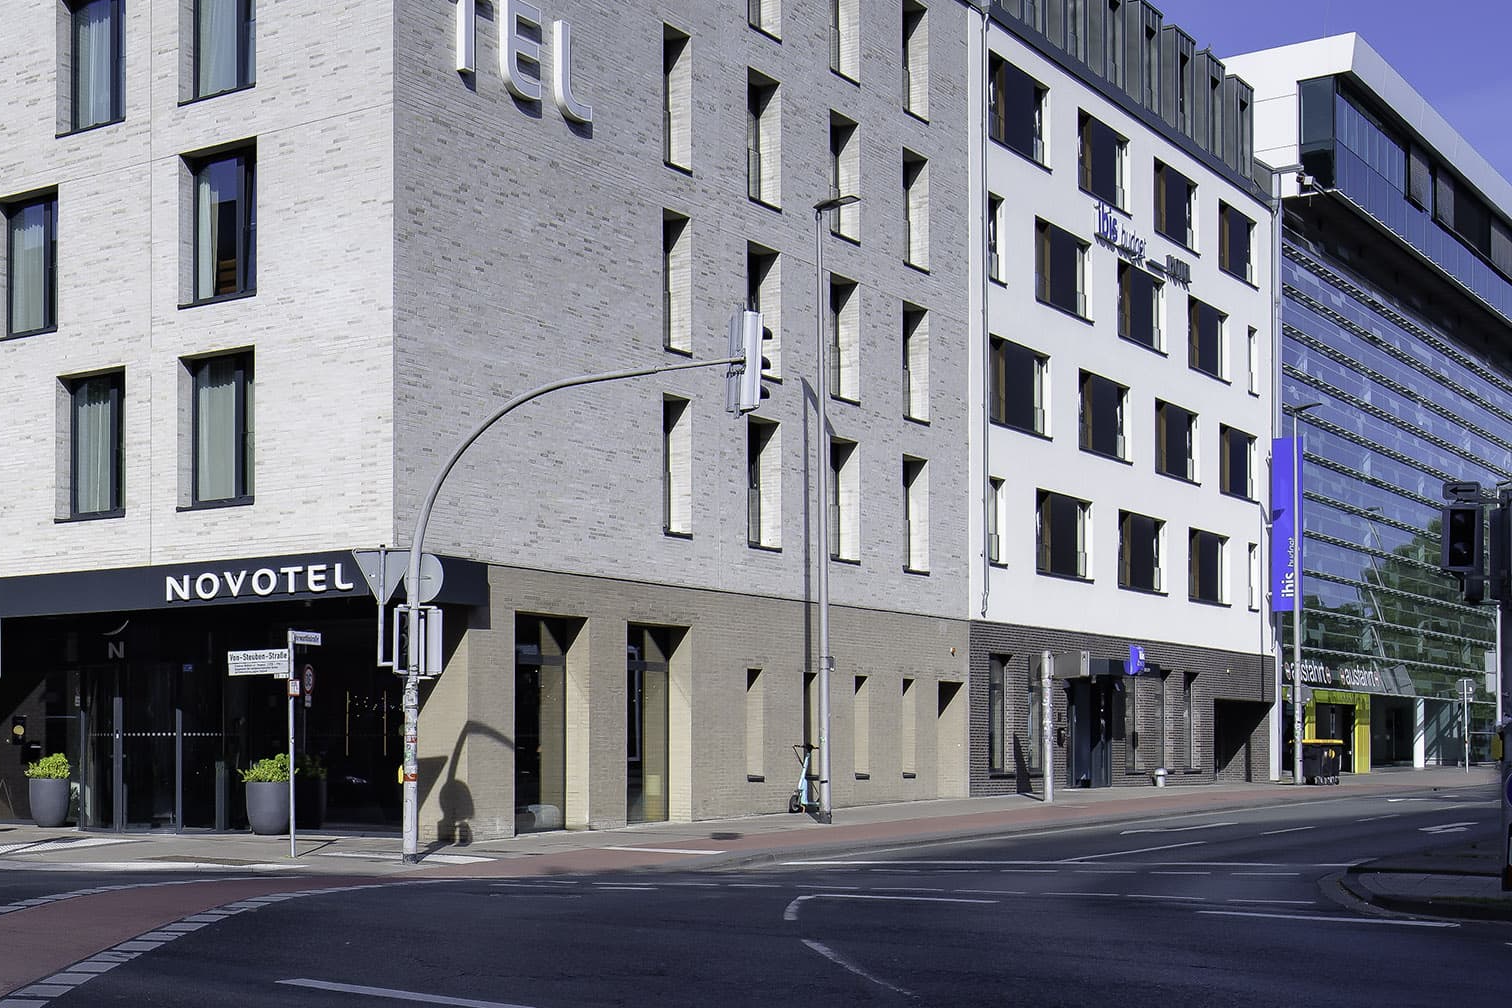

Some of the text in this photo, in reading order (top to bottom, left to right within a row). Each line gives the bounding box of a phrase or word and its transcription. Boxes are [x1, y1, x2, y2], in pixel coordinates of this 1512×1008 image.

[165, 563, 354, 601] NOVOTEL
[108, 641, 125, 659] N
[229, 651, 288, 662] Von-Steuben-Straße
[1291, 659, 1328, 684] asfahrt
[1344, 664, 1376, 687] ausfahrt
